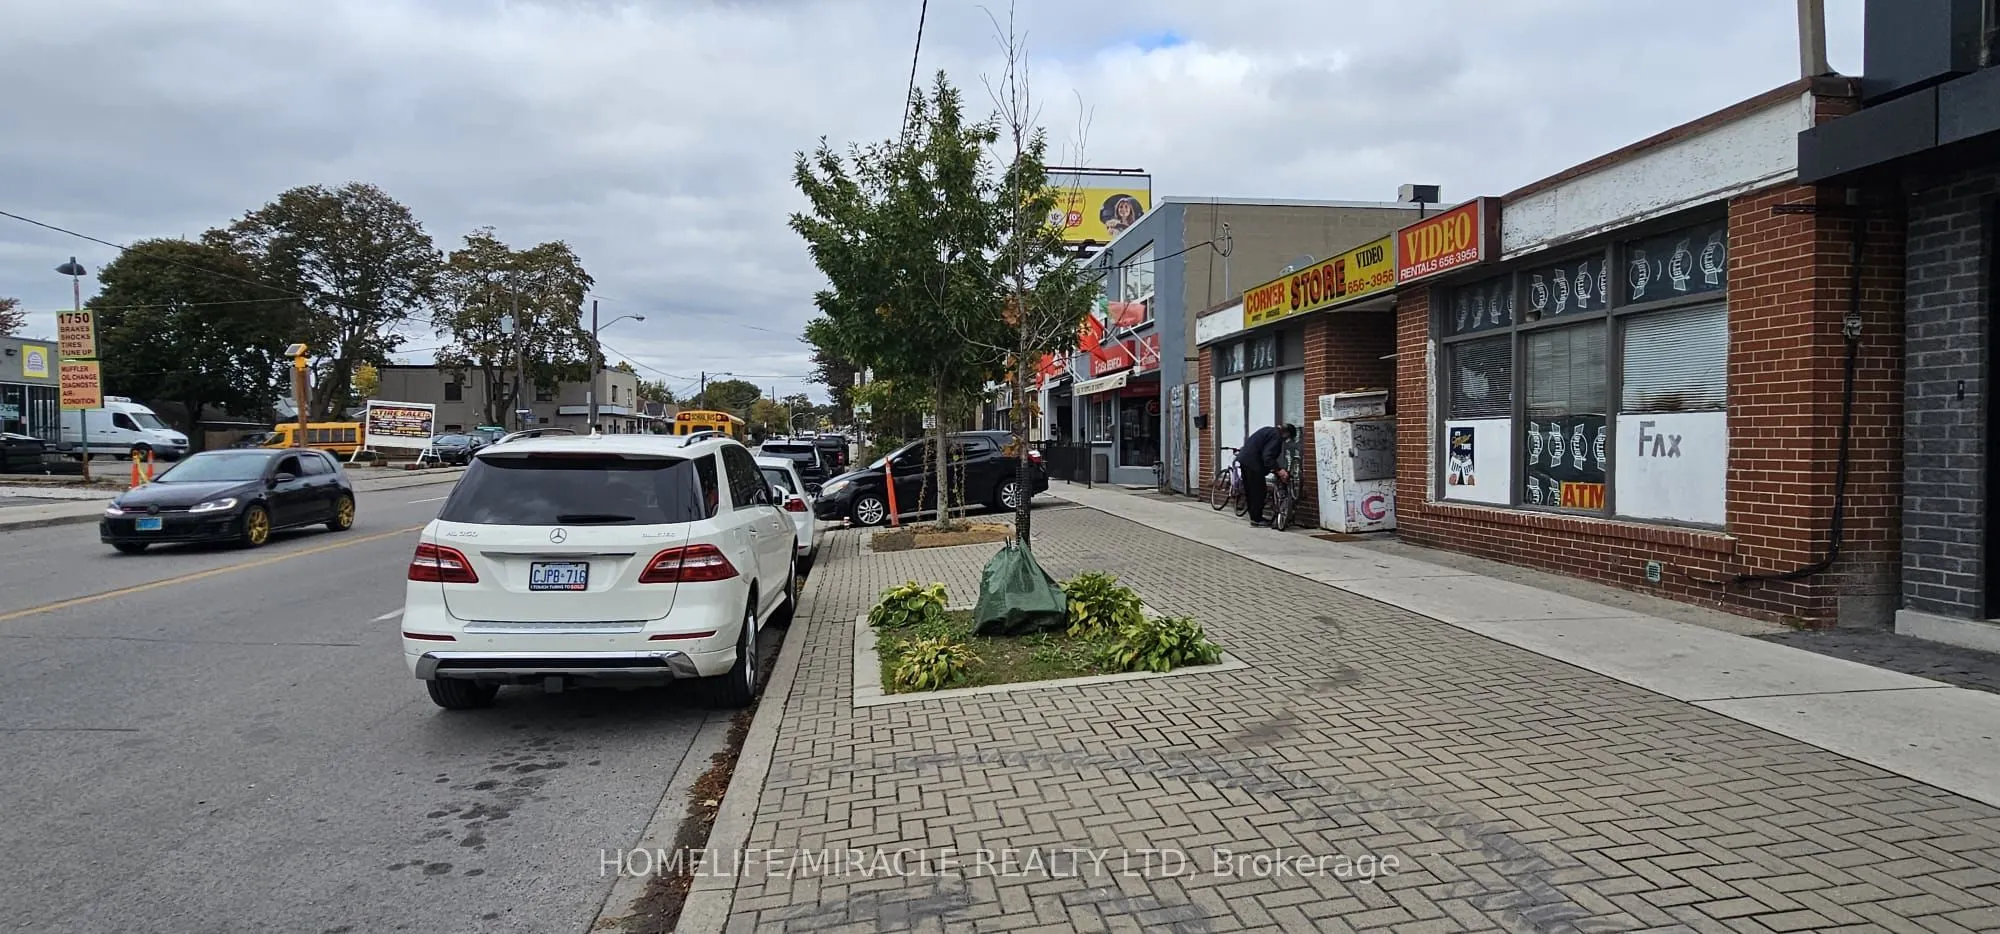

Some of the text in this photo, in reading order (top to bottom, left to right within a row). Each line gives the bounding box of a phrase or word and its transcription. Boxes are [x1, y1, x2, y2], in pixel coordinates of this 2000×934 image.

[1406, 212, 1471, 265] VIDEO
[1355, 245, 1384, 269] VIDEO
[1400, 247, 1477, 280] RENTALS 656-3956
[1246, 259, 1346, 315] CORNER STORE
[1347, 269, 1394, 294] 656-3956
[59, 313, 90, 323] 1750
